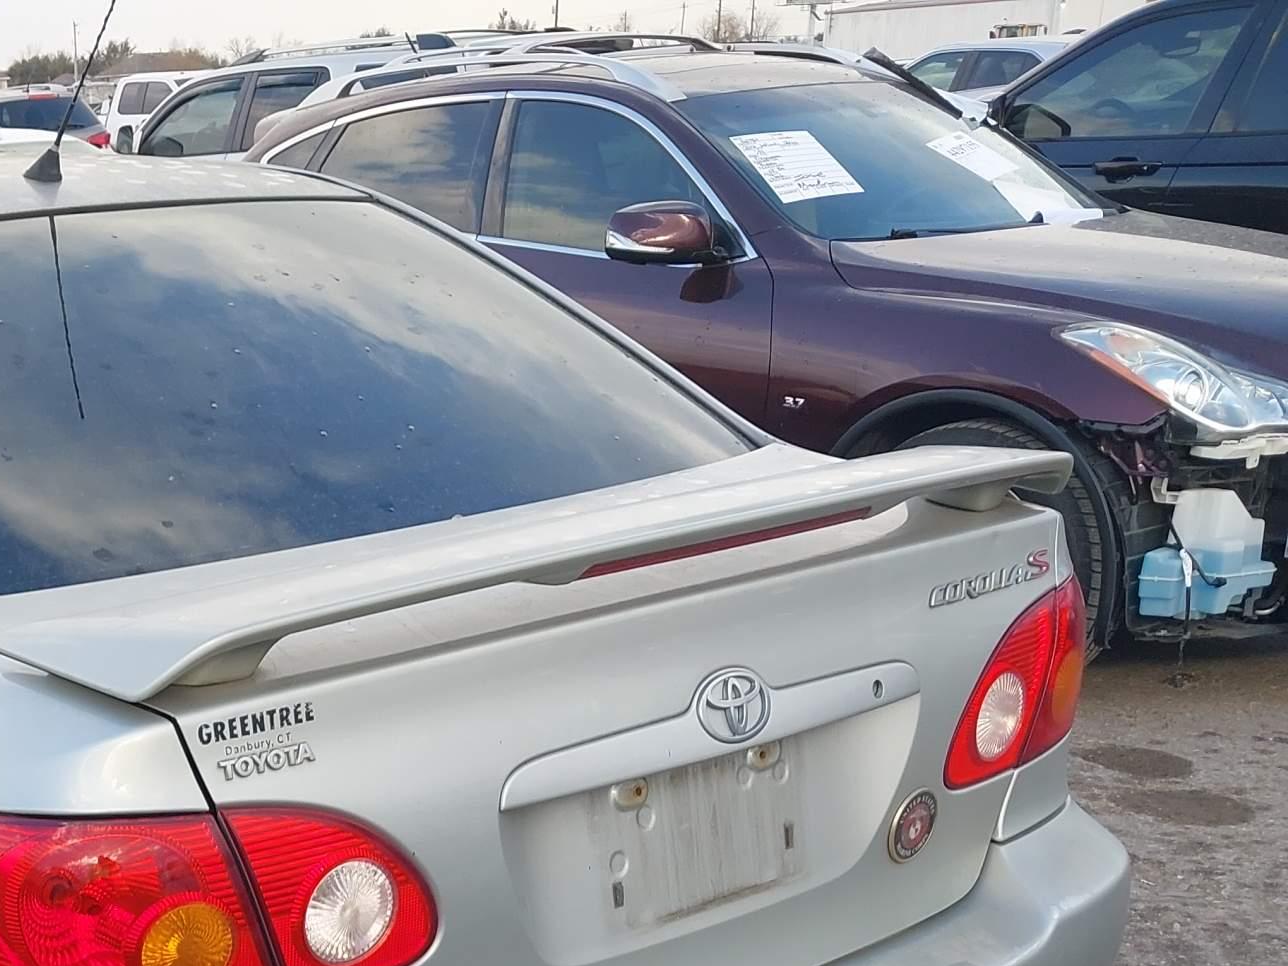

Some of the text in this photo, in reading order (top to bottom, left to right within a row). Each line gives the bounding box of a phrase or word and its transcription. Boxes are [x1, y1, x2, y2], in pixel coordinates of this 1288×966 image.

[928, 548, 1050, 608] COROLLA S
[197, 701, 315, 746] GREENTREE
[216, 741, 316, 781] TOYOTA
[224, 738, 275, 756] Danbury,
